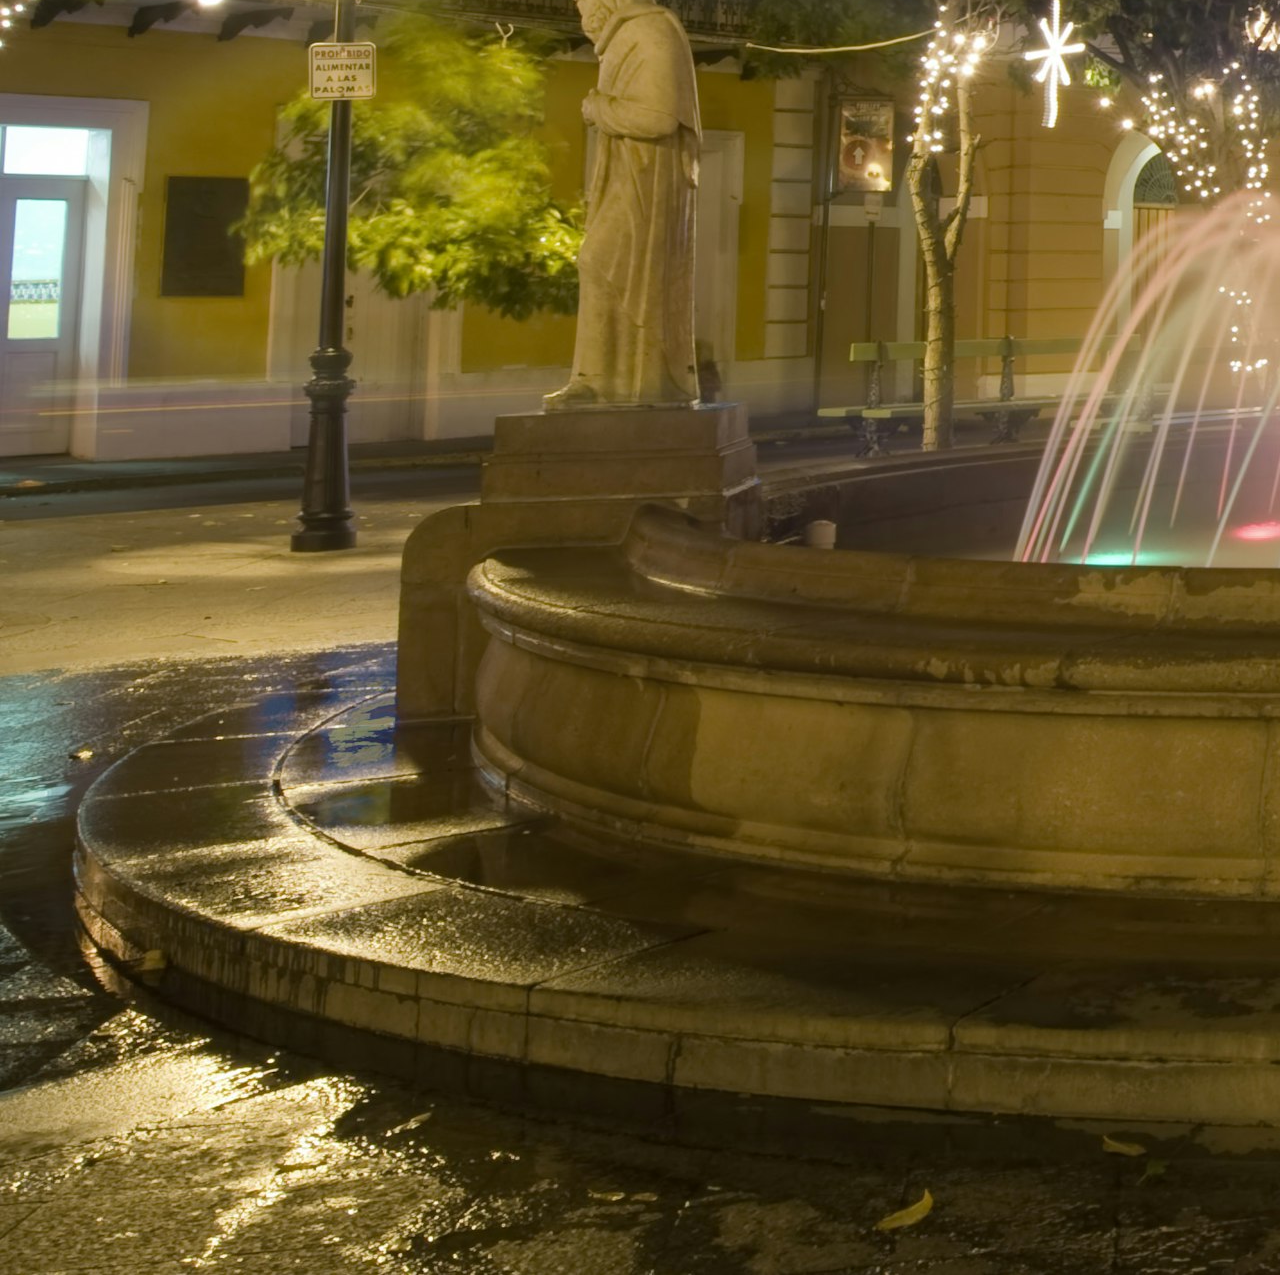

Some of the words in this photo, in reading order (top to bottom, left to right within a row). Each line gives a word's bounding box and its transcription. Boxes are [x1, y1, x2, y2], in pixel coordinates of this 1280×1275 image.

[314, 49, 371, 58] PROHBIDO
[315, 63, 371, 72] ALIMENTAR
[337, 74, 358, 82] LAS
